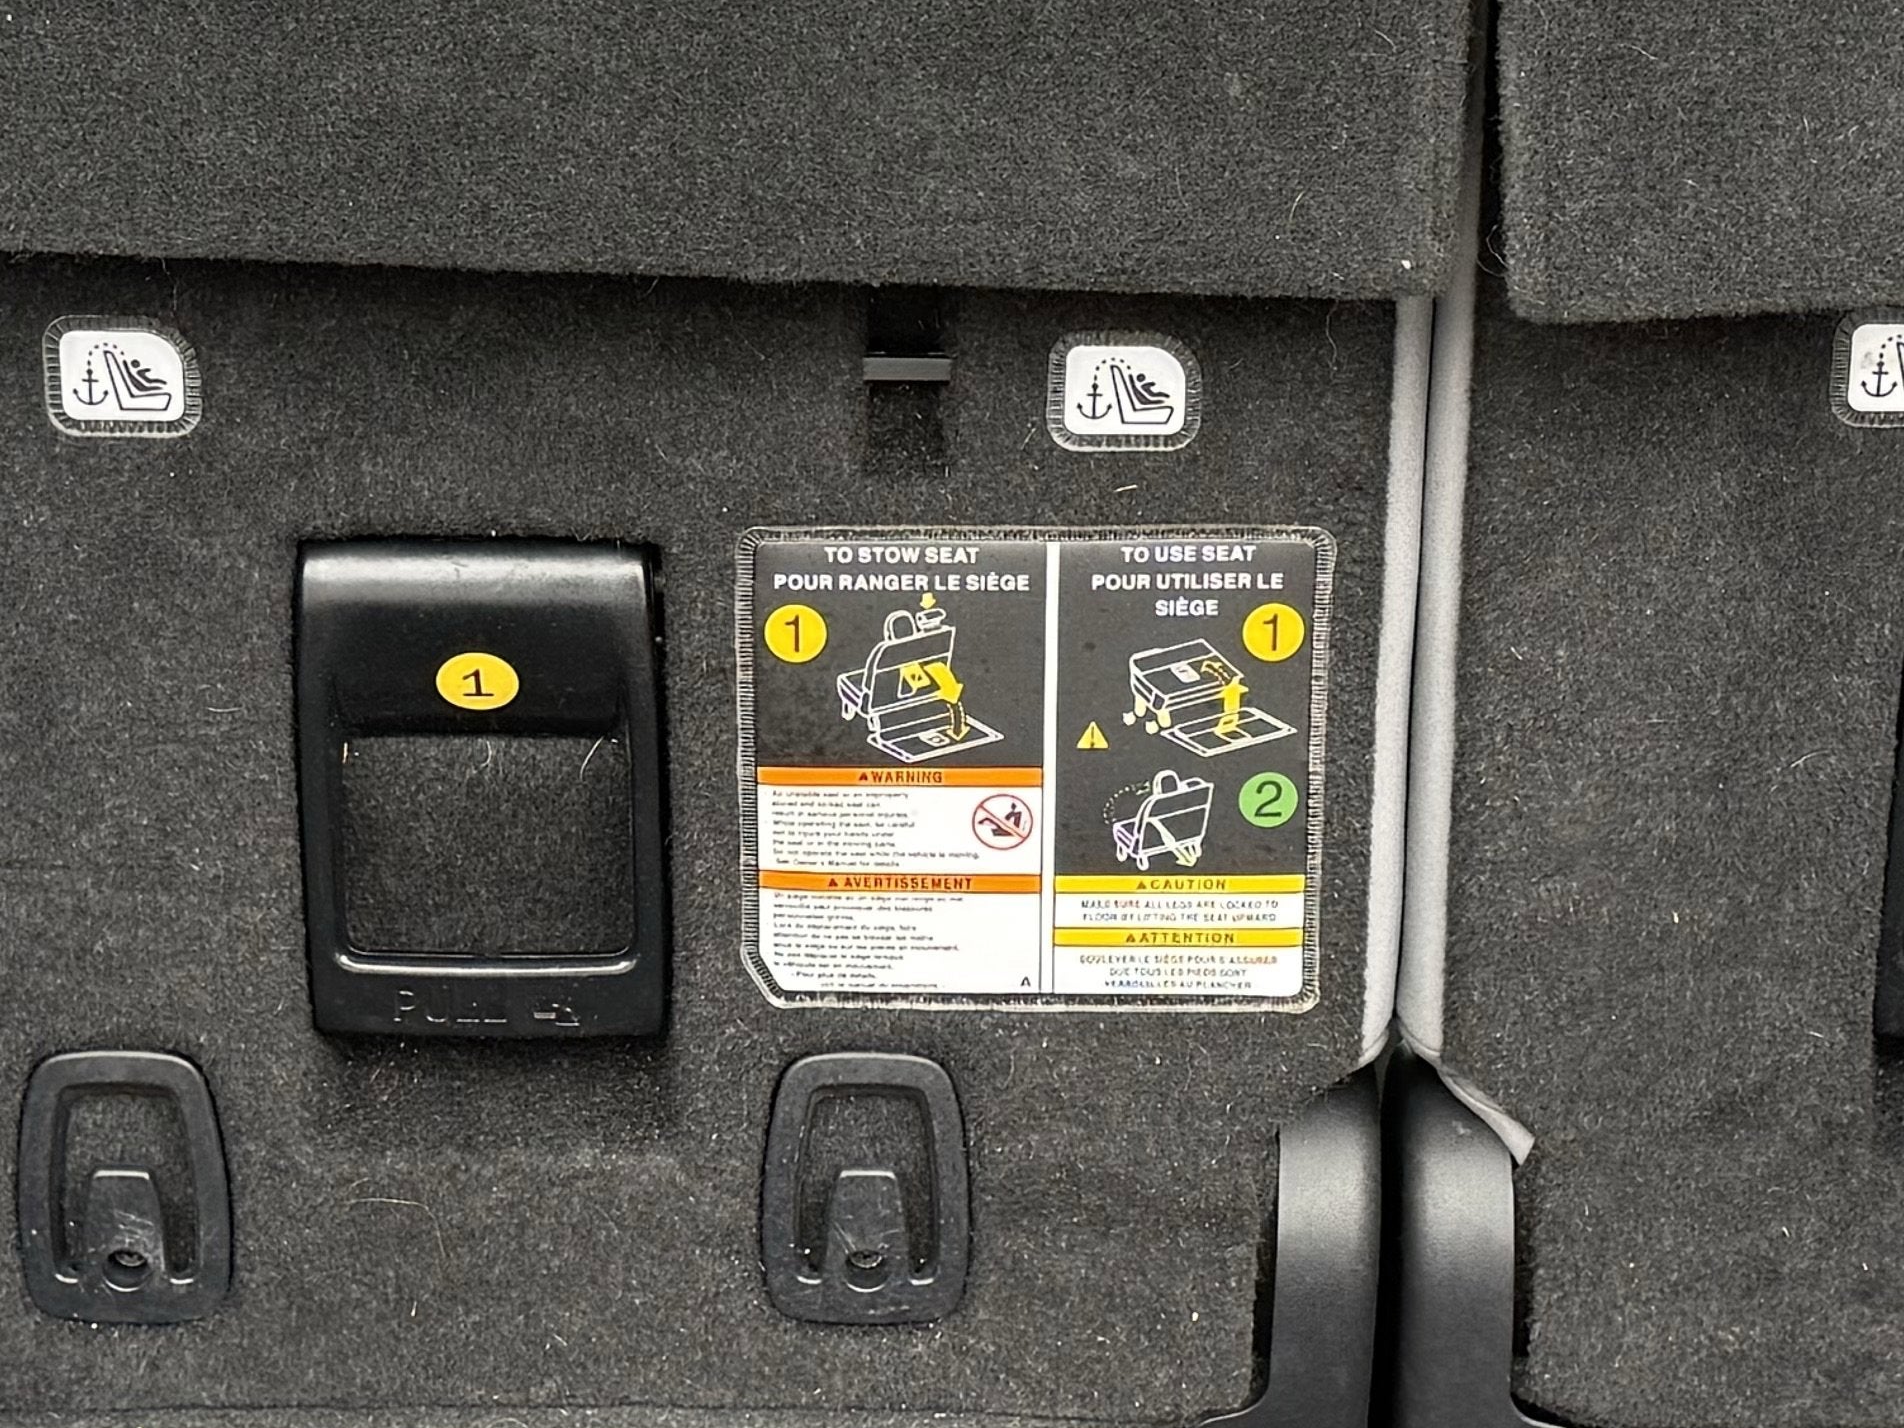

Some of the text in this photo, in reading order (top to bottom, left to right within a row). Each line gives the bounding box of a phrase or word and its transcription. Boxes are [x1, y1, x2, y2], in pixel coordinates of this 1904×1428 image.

[824, 546, 980, 564] TO STOW SEAT
[1121, 545, 1257, 563] TO USE SEAT
[773, 571, 1030, 591] POUR RANGER LE SIÈGE
[1091, 573, 1284, 590] POUR UTILISER LE
[1155, 596, 1219, 616] SIÈGE
[784, 614, 800, 653] 1
[1263, 613, 1279, 652] 1
[461, 668, 495, 698] 1
[872, 770, 943, 783] WARNING
[1255, 780, 1282, 818] 2
[843, 877, 973, 890] AVERTISSEMENT
[1150, 879, 1227, 890] CAUTION
[1139, 932, 1235, 943] ATTENTION
[1020, 976, 1032, 987] A
